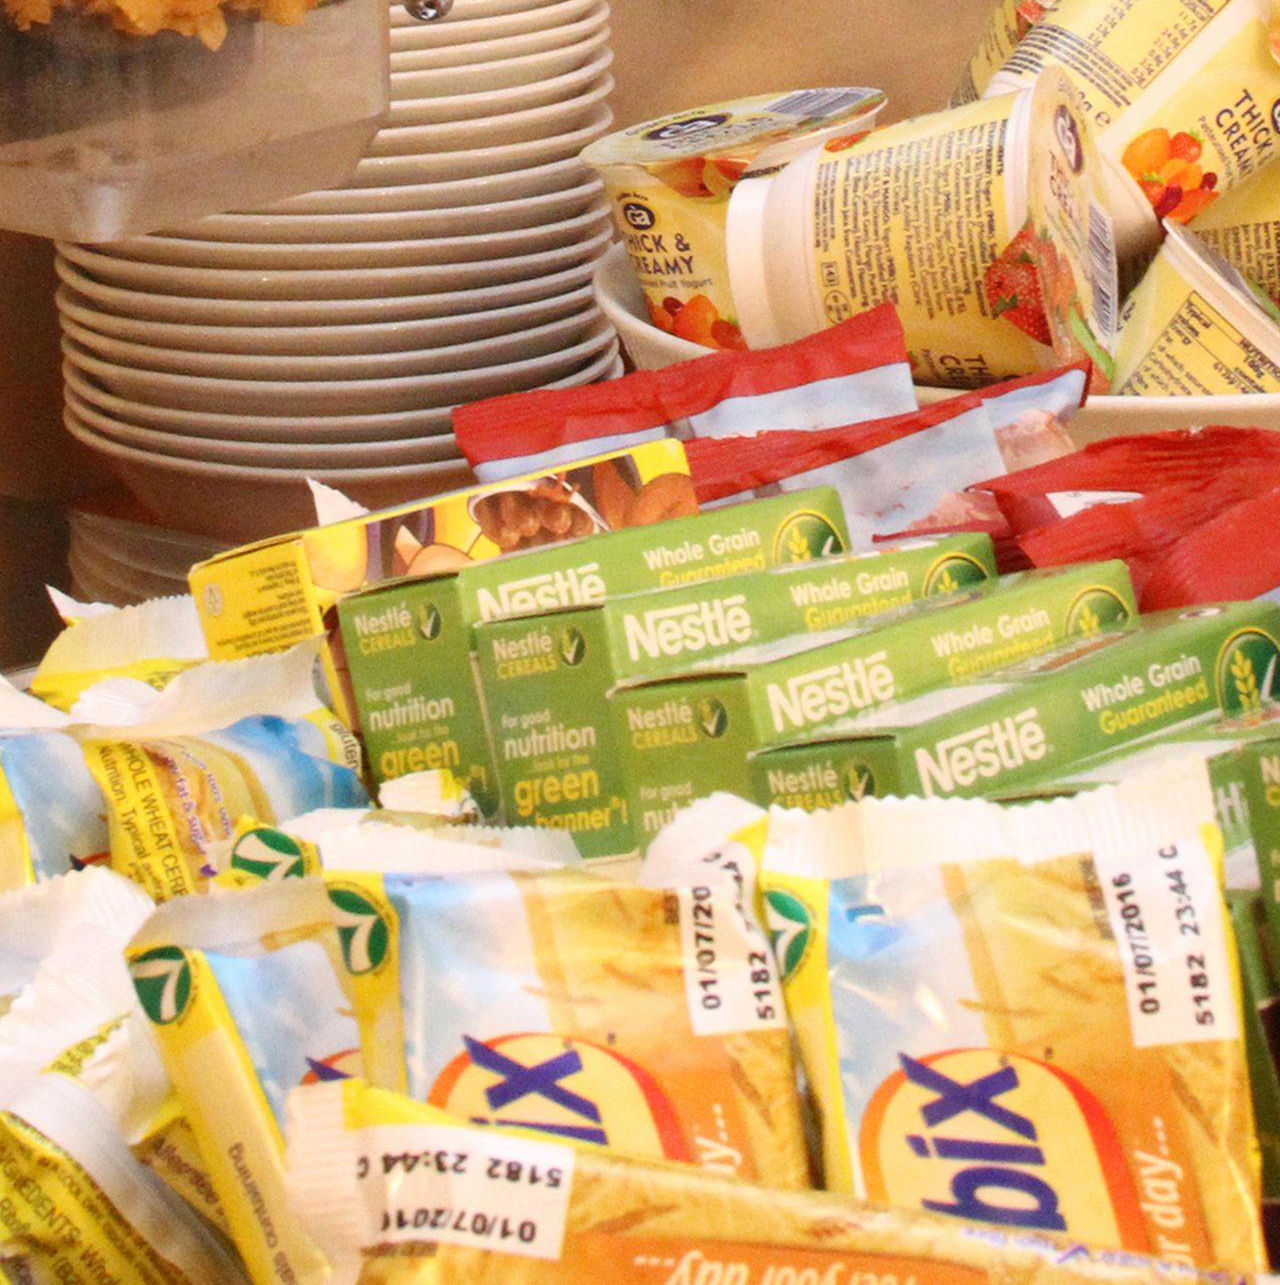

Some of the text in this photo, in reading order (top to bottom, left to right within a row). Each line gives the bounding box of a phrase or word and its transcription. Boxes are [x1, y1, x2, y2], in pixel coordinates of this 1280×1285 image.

[1234, 88, 1274, 156] THICK
[628, 233, 691, 254] HICK &
[1184, 299, 1213, 330] Typical
[642, 527, 762, 572] Whole Grain
[789, 566, 909, 608] Whole Grain
[359, 634, 417, 656] CEREALS
[930, 606, 1051, 659] Whole Grain
[496, 653, 558, 681] CEREALS
[1080, 654, 1202, 713] Whole Grain
[369, 696, 455, 732] nutrition
[1099, 675, 1209, 735] Guaranteed
[330, 721, 361, 773] gluten
[380, 739, 461, 780] green
[504, 724, 597, 760] nutrition
[632, 727, 699, 751] CEREALS
[514, 770, 601, 817] green
[118, 807, 150, 861] Typical
[138, 792, 174, 853] WHEAT
[691, 884, 722, 1011] 01/07/20
[1111, 872, 1161, 1015] 01/07/2016
[1158, 843, 1215, 1026] 5182 23:44 C
[748, 951, 775, 1020] 5182
[381, 1152, 469, 1175] 23:44
[485, 1157, 564, 1188] 5182
[1133, 1115, 1186, 1230] day...
[225, 1141, 282, 1250] containing
[380, 1208, 537, 1244] 01/07/201
